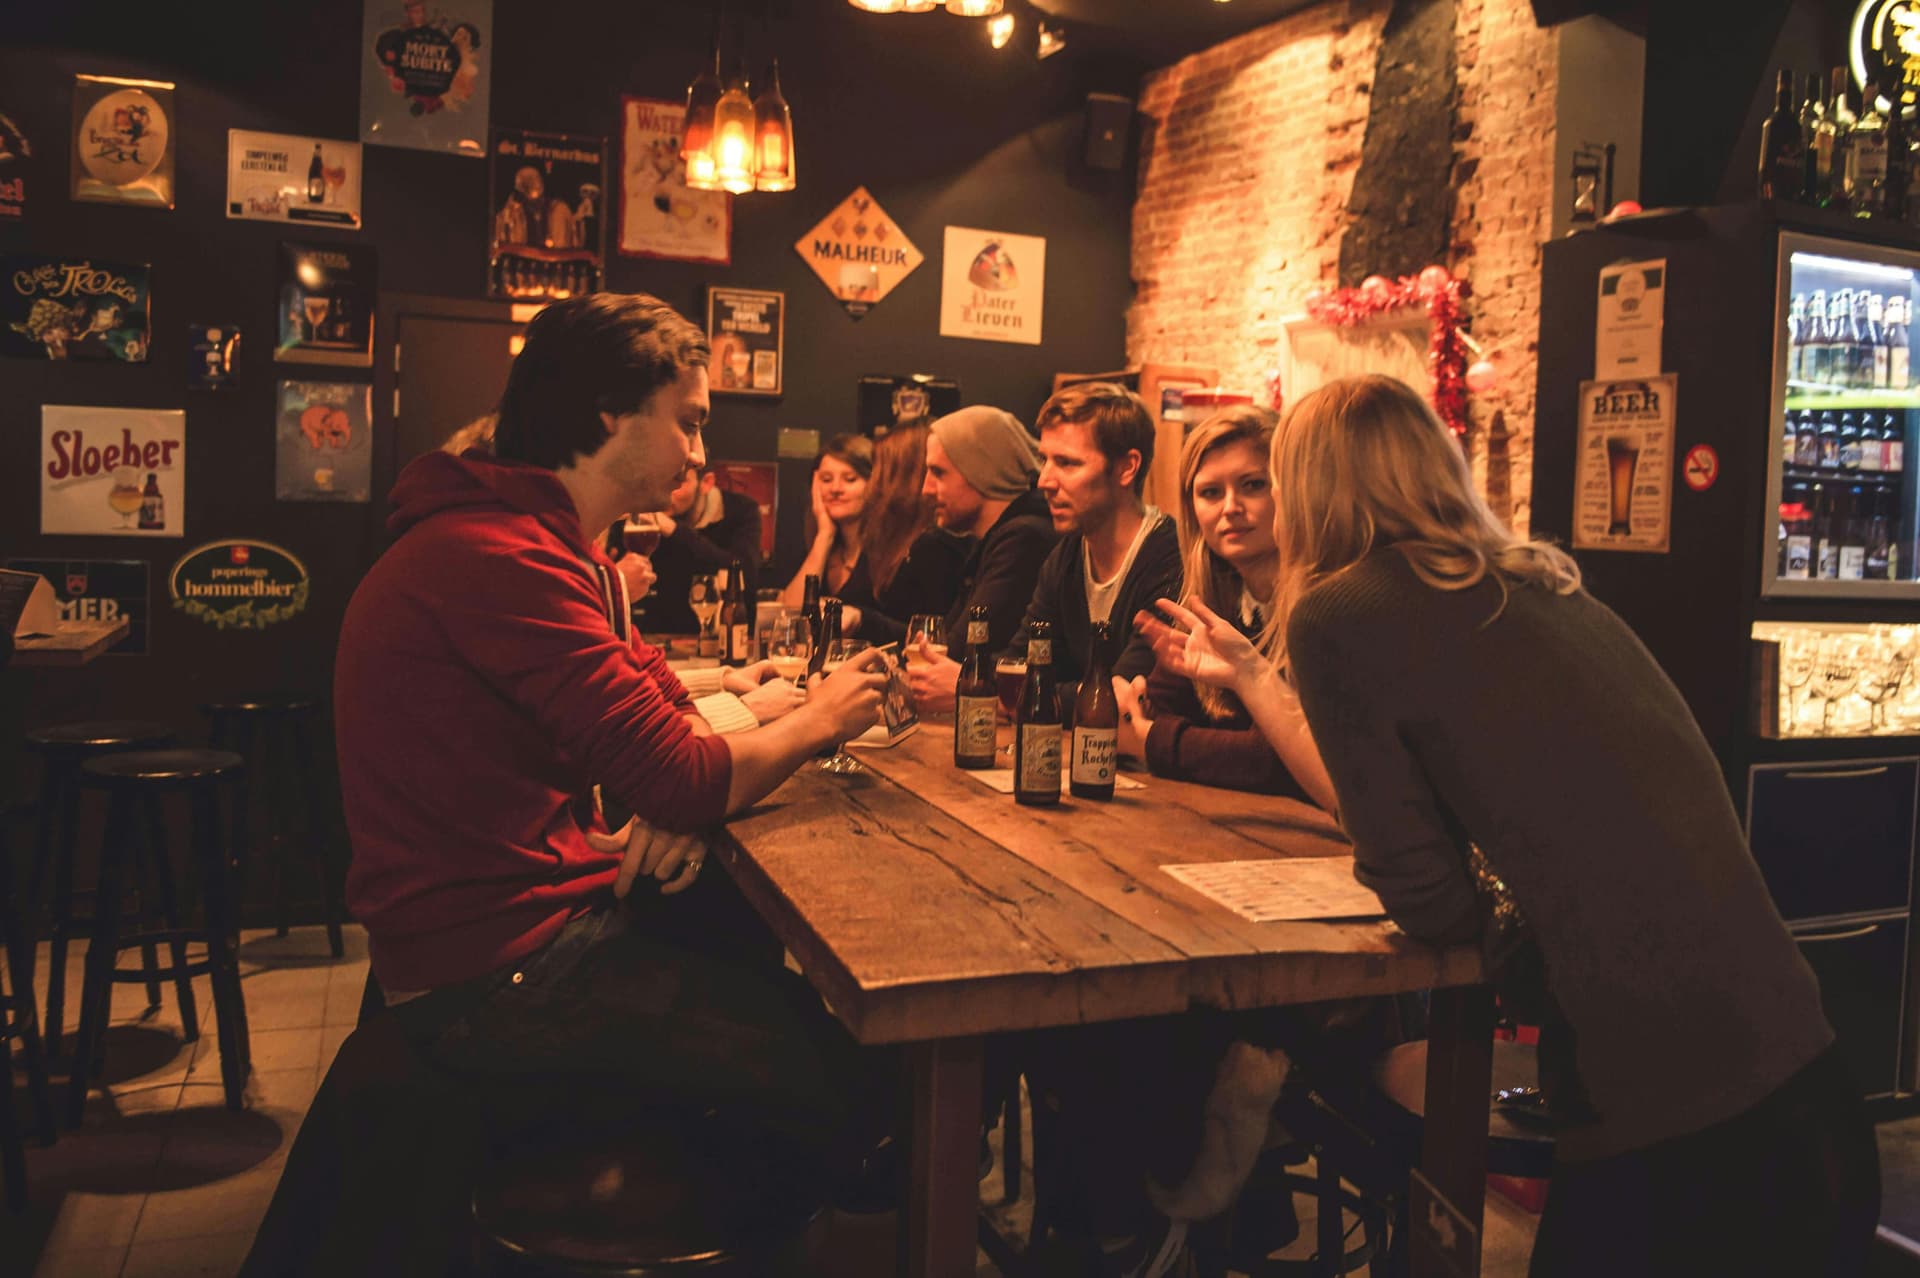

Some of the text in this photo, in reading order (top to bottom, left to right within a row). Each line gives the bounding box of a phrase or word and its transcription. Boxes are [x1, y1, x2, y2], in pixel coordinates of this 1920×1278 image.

[405, 41, 448, 58] MORT
[400, 53, 453, 72] SUBITE
[814, 239, 907, 266] MALHEUR
[973, 290, 1015, 310] Pater
[960, 303, 1022, 328] Lieven
[1593, 391, 1659, 414] BEER
[48, 427, 179, 479] Sloeber
[184, 578, 295, 597] hommelbier
